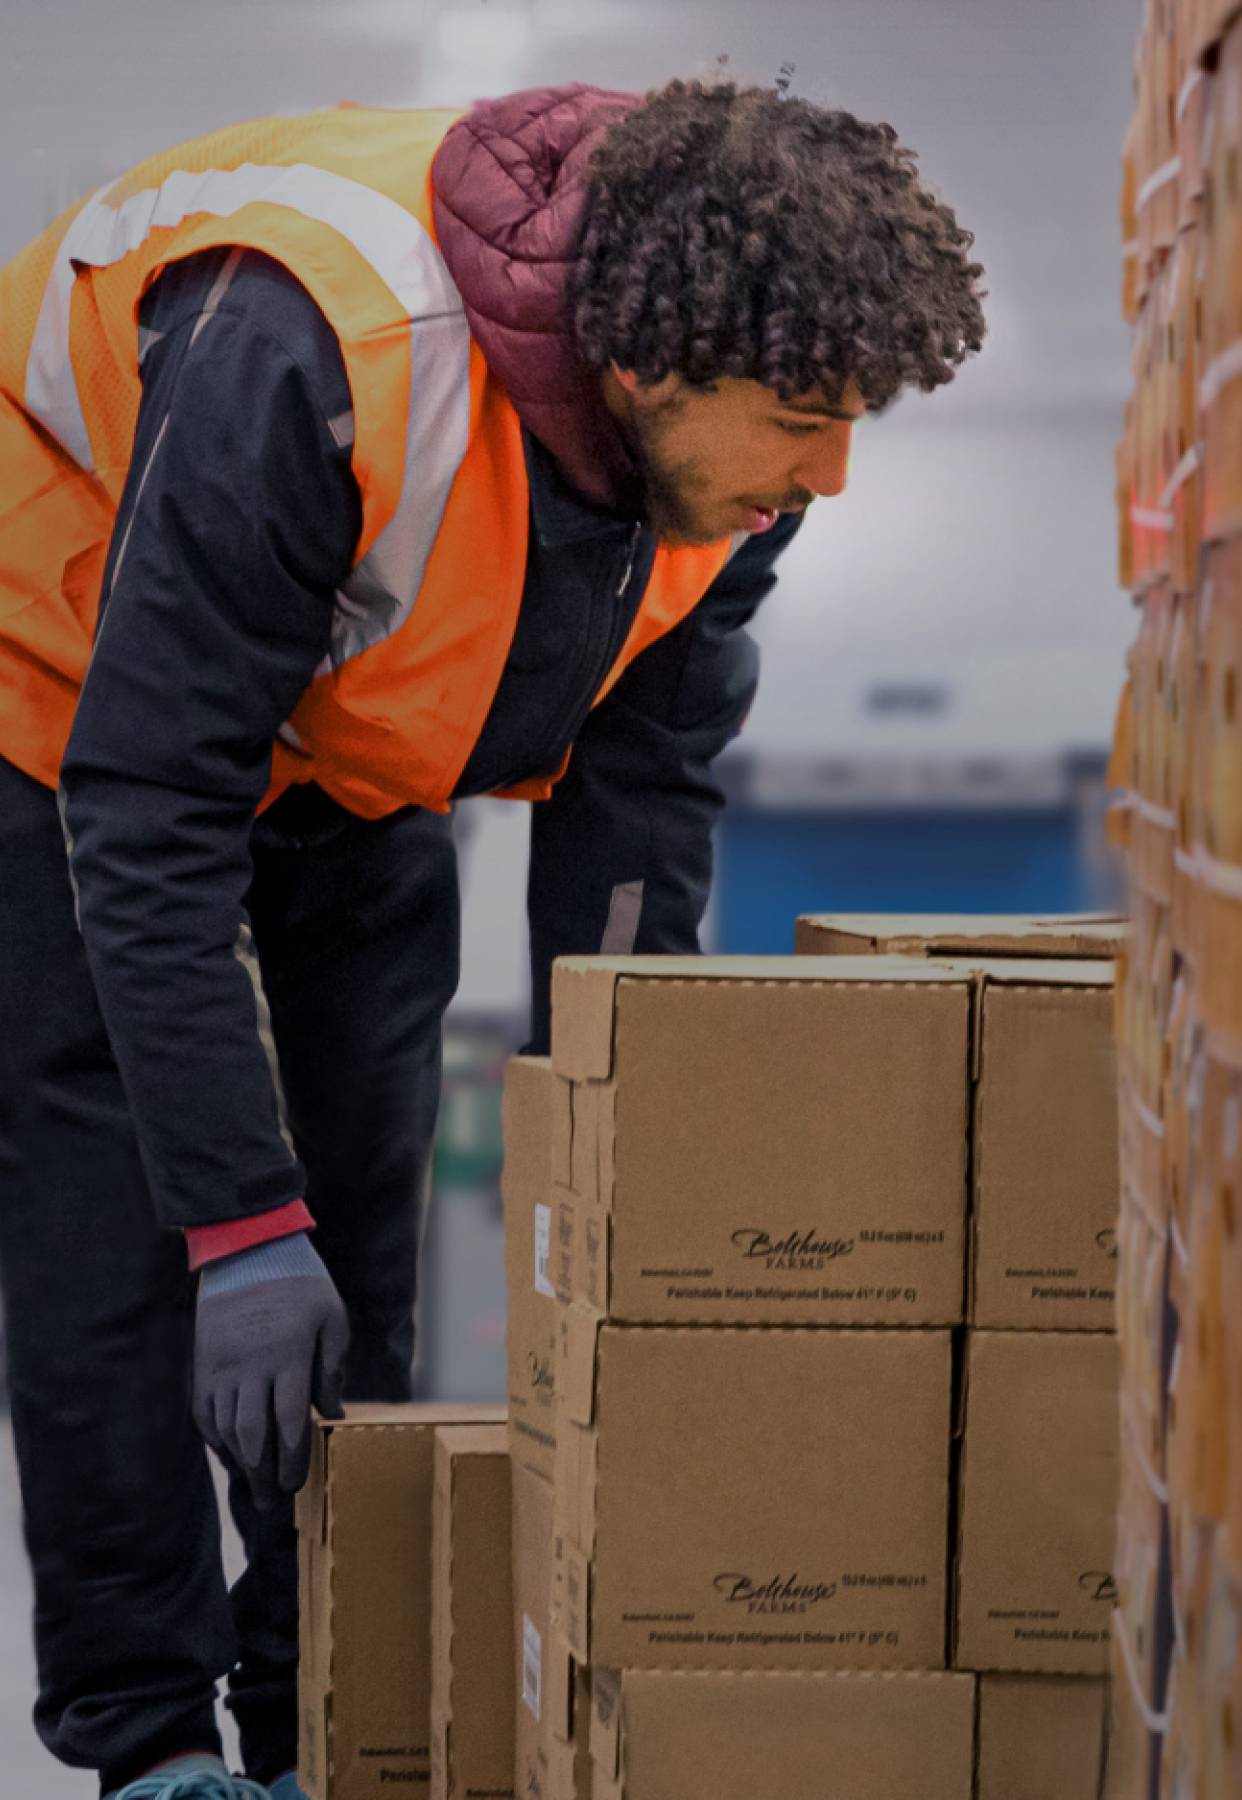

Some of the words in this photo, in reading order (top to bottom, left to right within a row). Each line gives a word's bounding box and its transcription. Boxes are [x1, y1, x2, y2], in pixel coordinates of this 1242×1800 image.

[731, 1228, 854, 1260] Bolthouse
[766, 1257, 824, 1270] FARMS
[667, 1286, 722, 1299] Perishable
[725, 1286, 752, 1301] Keep
[755, 1286, 819, 1301] Refrigerated
[713, 1572, 837, 1604] Bolthouse
[747, 1600, 806, 1613] FARMS
[707, 1630, 735, 1647] Keep
